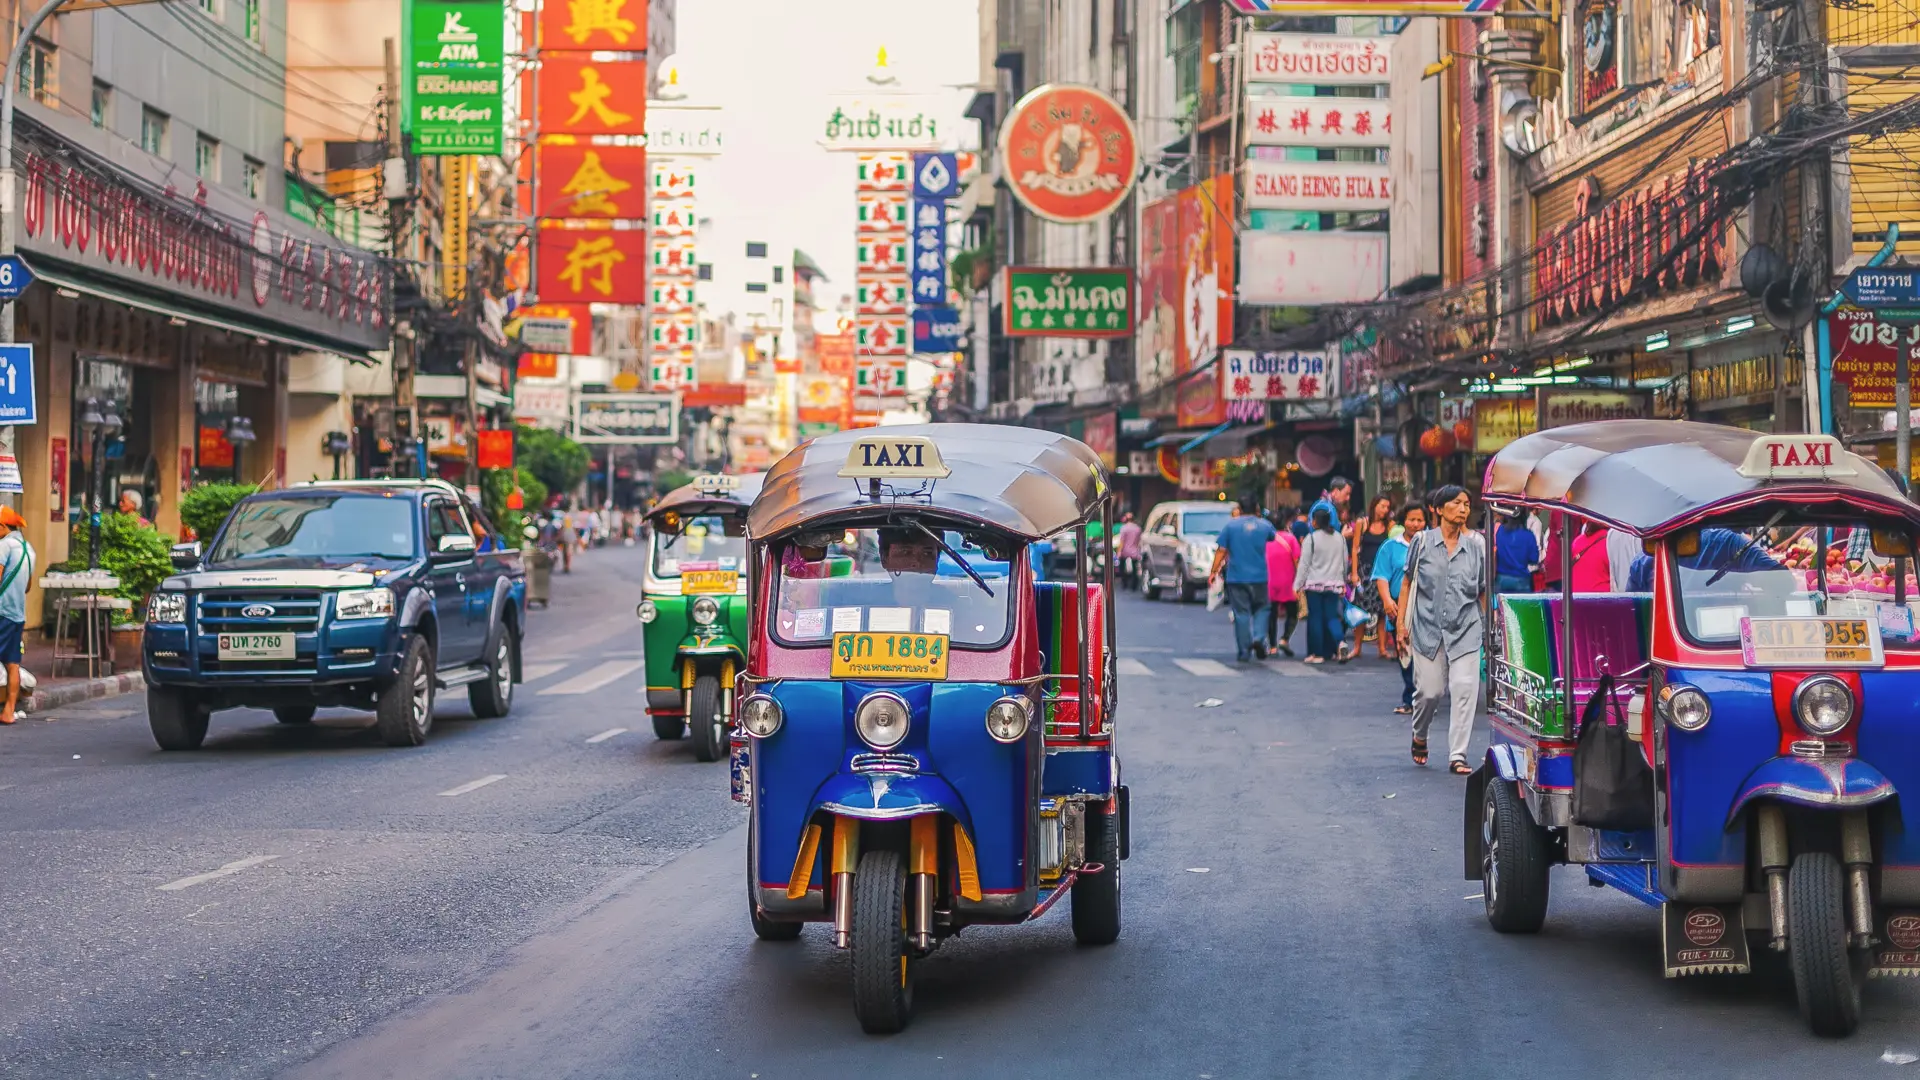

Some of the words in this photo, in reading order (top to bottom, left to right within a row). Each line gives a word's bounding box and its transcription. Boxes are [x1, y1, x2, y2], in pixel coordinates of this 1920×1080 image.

[439, 44, 479, 60] ATM
[417, 80, 498, 94] EXCHANGE
[421, 102, 492, 124] K-Expert
[420, 135, 494, 145] WISDOM
[1255, 174, 1297, 196] SIANG
[1302, 175, 1341, 198] HENG
[1346, 176, 1375, 199] HUA
[859, 443, 925, 467] TAXI
[1767, 443, 1833, 467] TAXI
[702, 477, 731, 485] TAXI
[710, 571, 737, 583] 7094
[248, 607, 267, 617] Ford
[1803, 621, 1867, 645] 2955
[253, 636, 281, 649] 2760
[886, 635, 943, 659] 1884
